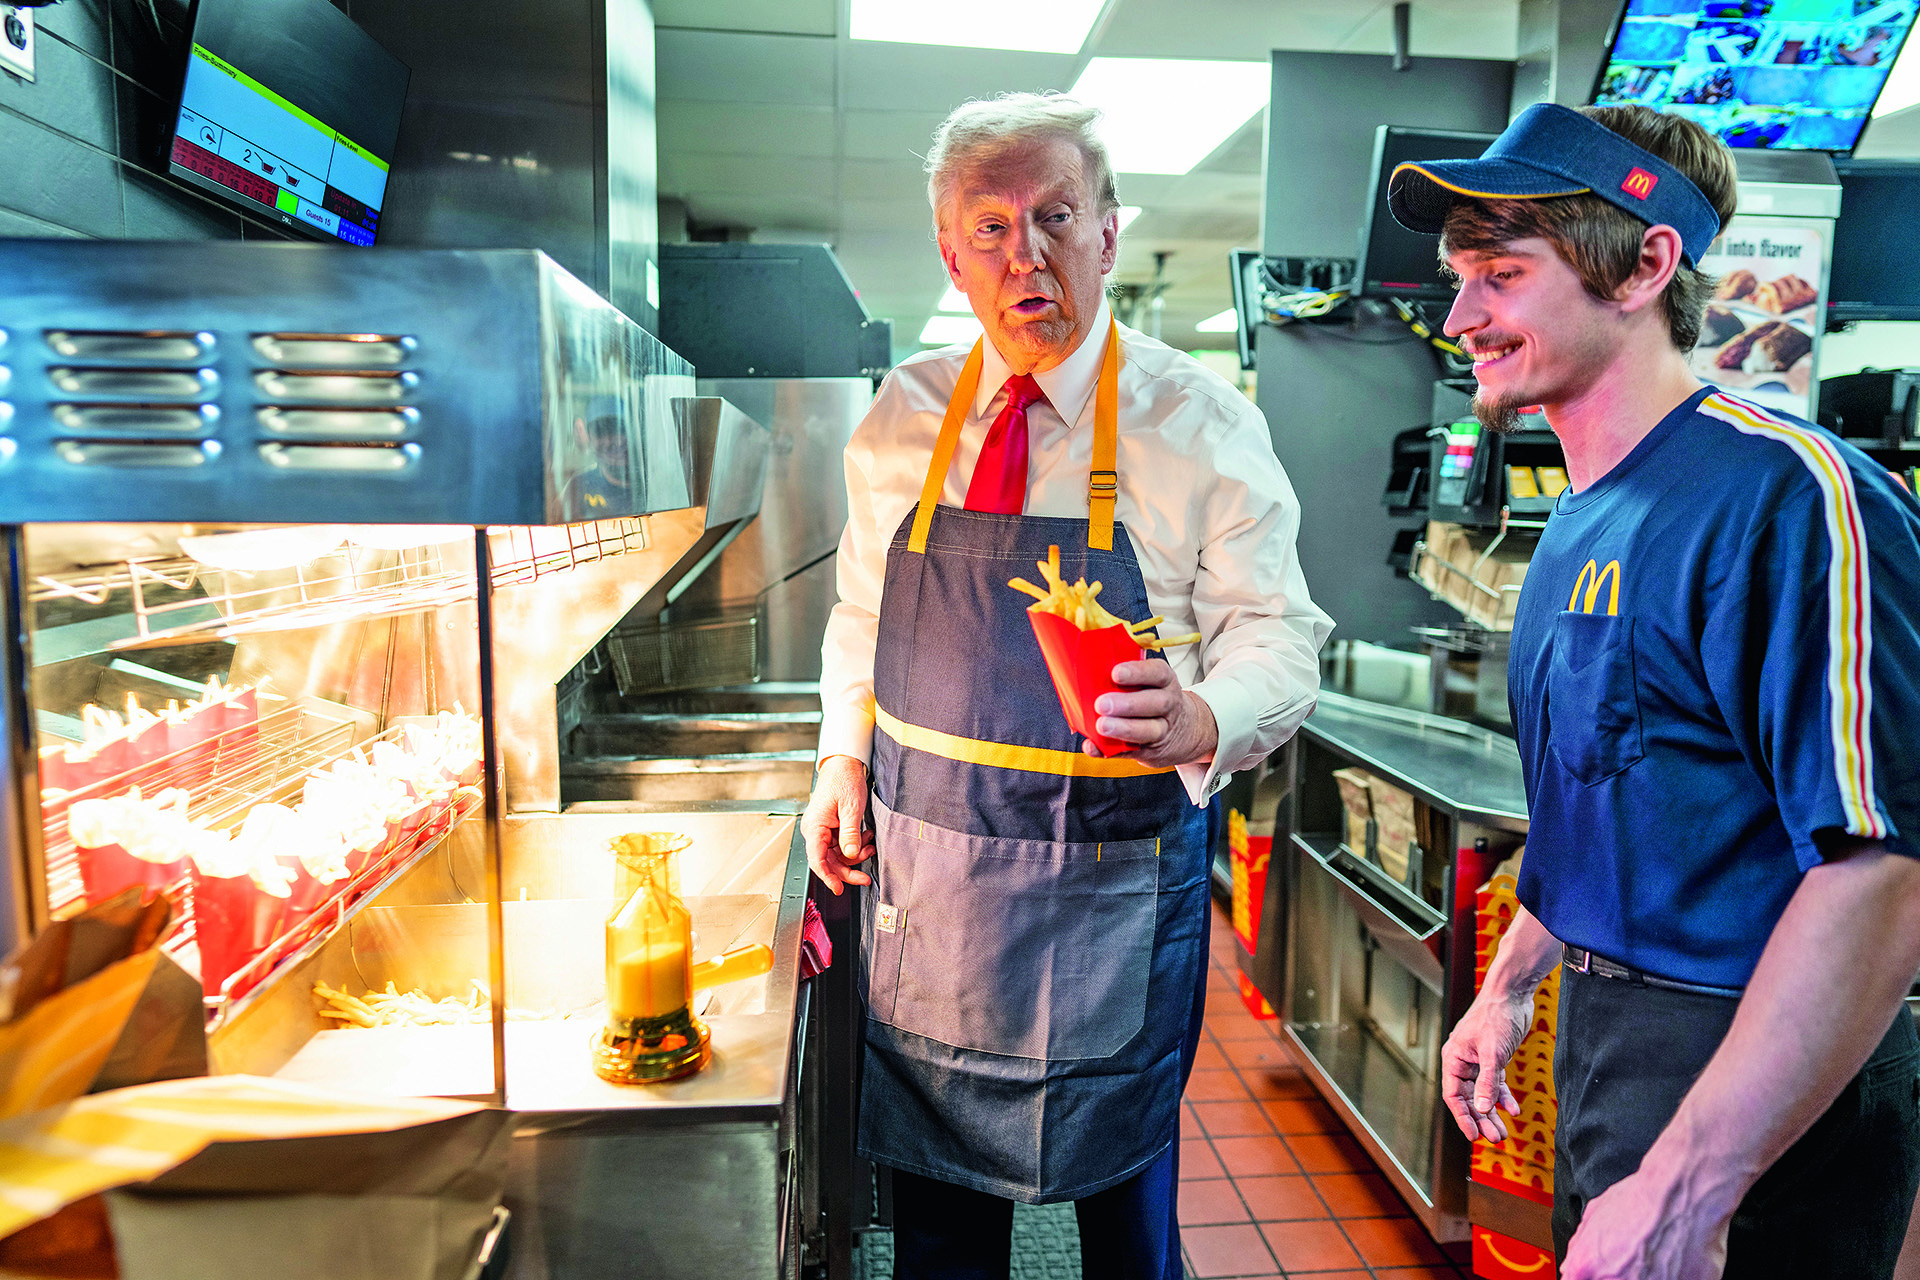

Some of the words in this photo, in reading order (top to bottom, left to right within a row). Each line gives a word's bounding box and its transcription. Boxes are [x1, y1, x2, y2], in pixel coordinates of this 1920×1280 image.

[194, 46, 238, 79] Fries-Summary
[336, 135, 359, 153] Fries-Level
[243, 148, 252, 163] 2
[331, 190, 351, 205] Update
[305, 209, 324, 223] Guests
[324, 217, 331, 226] 15
[1726, 239, 1756, 256] into
[1760, 239, 1802, 257] flavor
